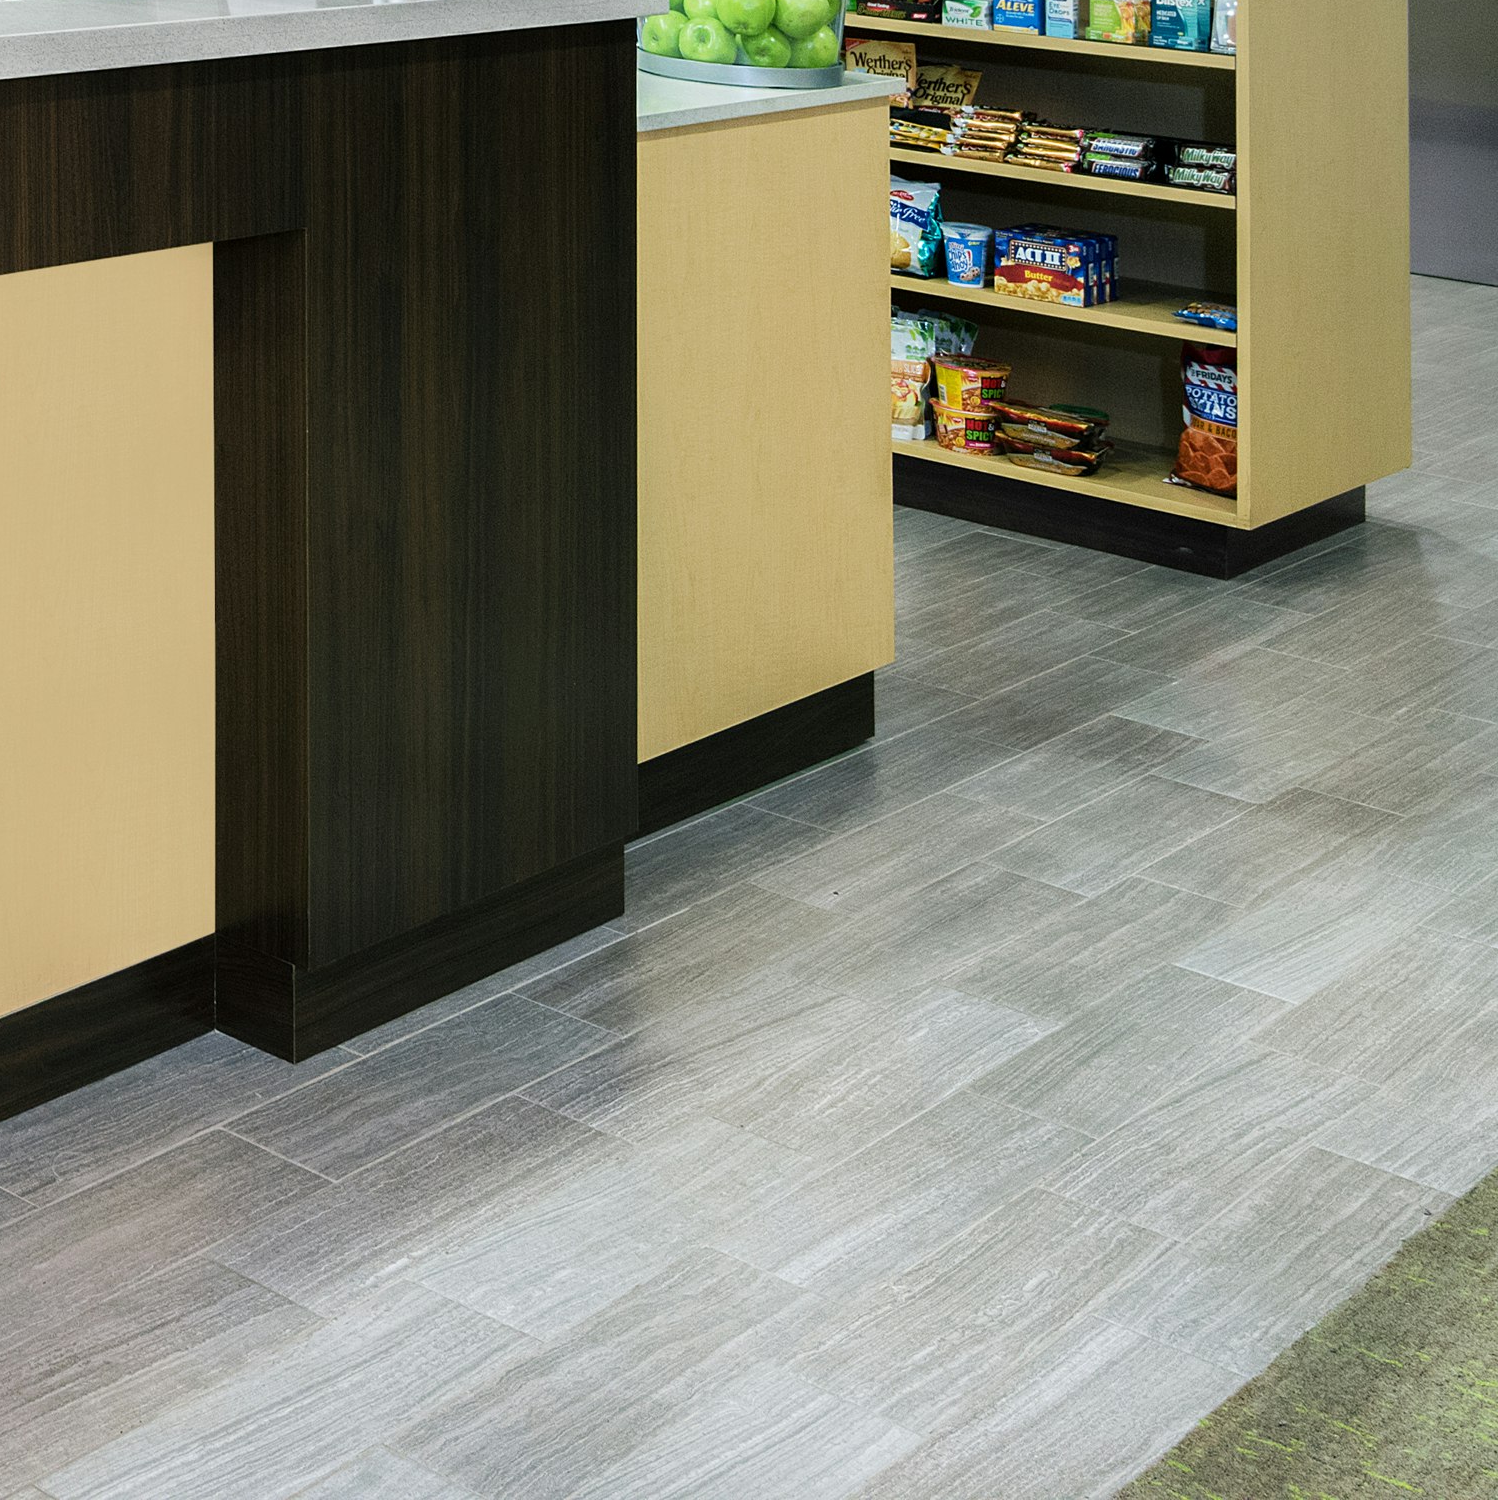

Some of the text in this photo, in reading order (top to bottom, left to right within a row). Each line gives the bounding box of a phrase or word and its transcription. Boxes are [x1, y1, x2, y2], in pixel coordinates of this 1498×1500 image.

[996, 0, 1035, 13] ALEVE
[945, 15, 983, 26] WHITE
[850, 51, 912, 71] Werther's
[913, 87, 966, 106] Original
[1015, 247, 1061, 266] ACT II
[1024, 269, 1054, 282] Butter
[1196, 370, 1233, 384] FRIDAYS
[1186, 387, 1237, 407] POTATO
[1215, 425, 1237, 438] BACO
